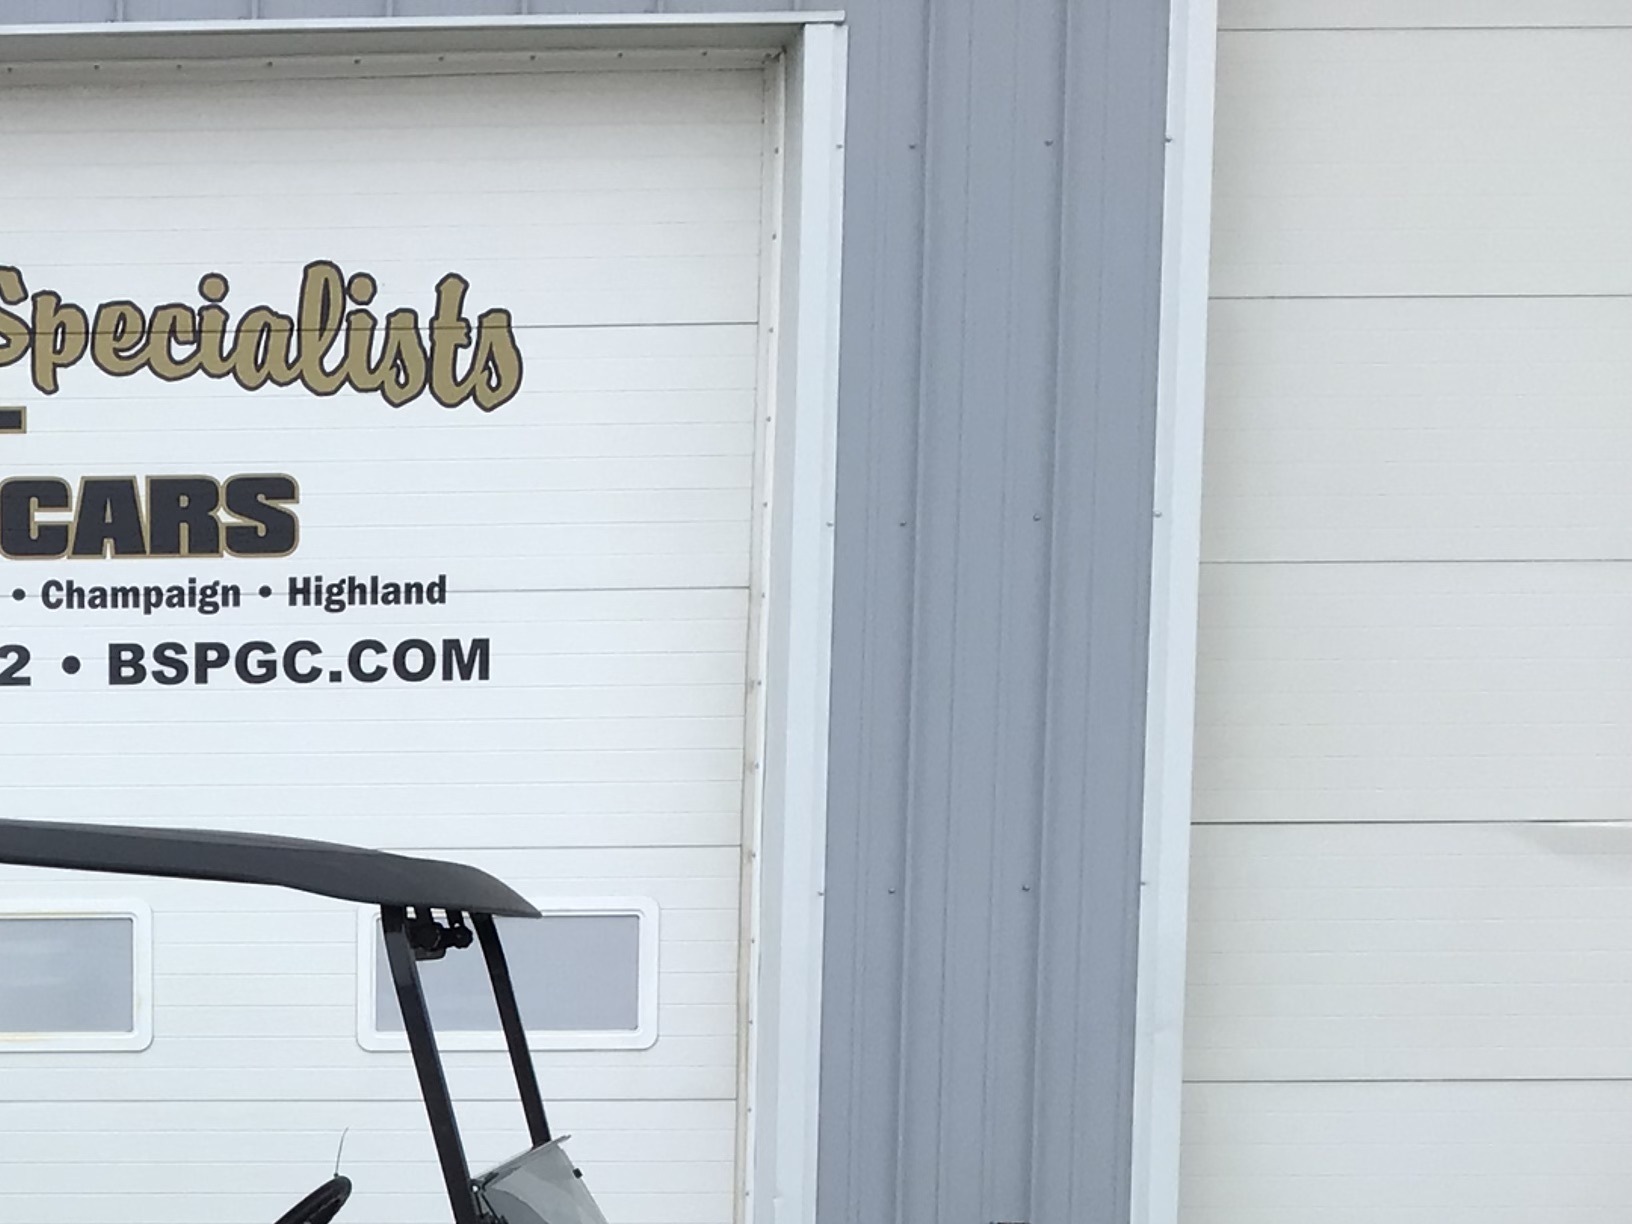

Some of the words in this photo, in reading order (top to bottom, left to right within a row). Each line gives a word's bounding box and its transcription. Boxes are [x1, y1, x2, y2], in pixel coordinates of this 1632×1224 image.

[40, 577, 242, 614] Champaign
[287, 574, 448, 608] Highland
[106, 637, 492, 686] BSPGC.COM
